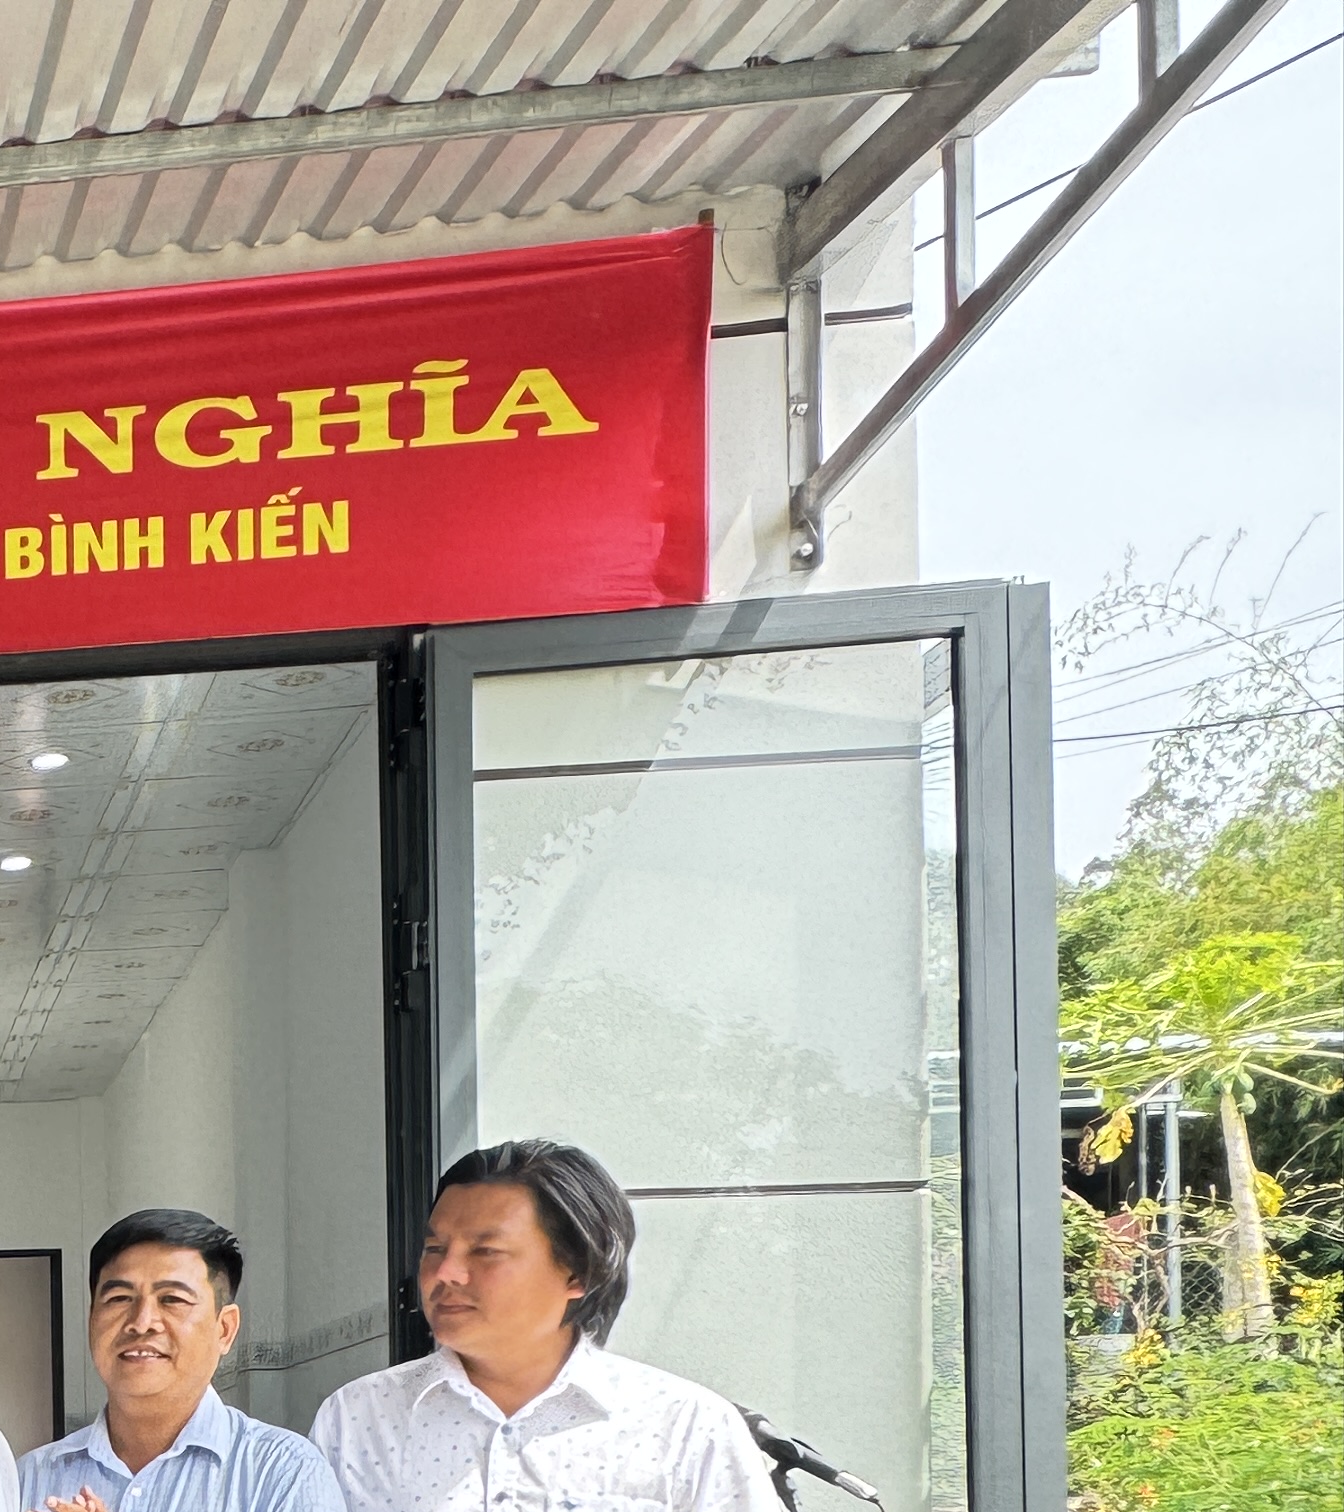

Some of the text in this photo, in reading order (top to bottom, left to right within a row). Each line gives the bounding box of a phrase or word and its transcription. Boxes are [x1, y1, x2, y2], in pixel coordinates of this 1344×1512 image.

[35, 358, 601, 482] NGHĨA
[4, 512, 166, 580] BÌNH
[190, 485, 351, 566] KIẾN
